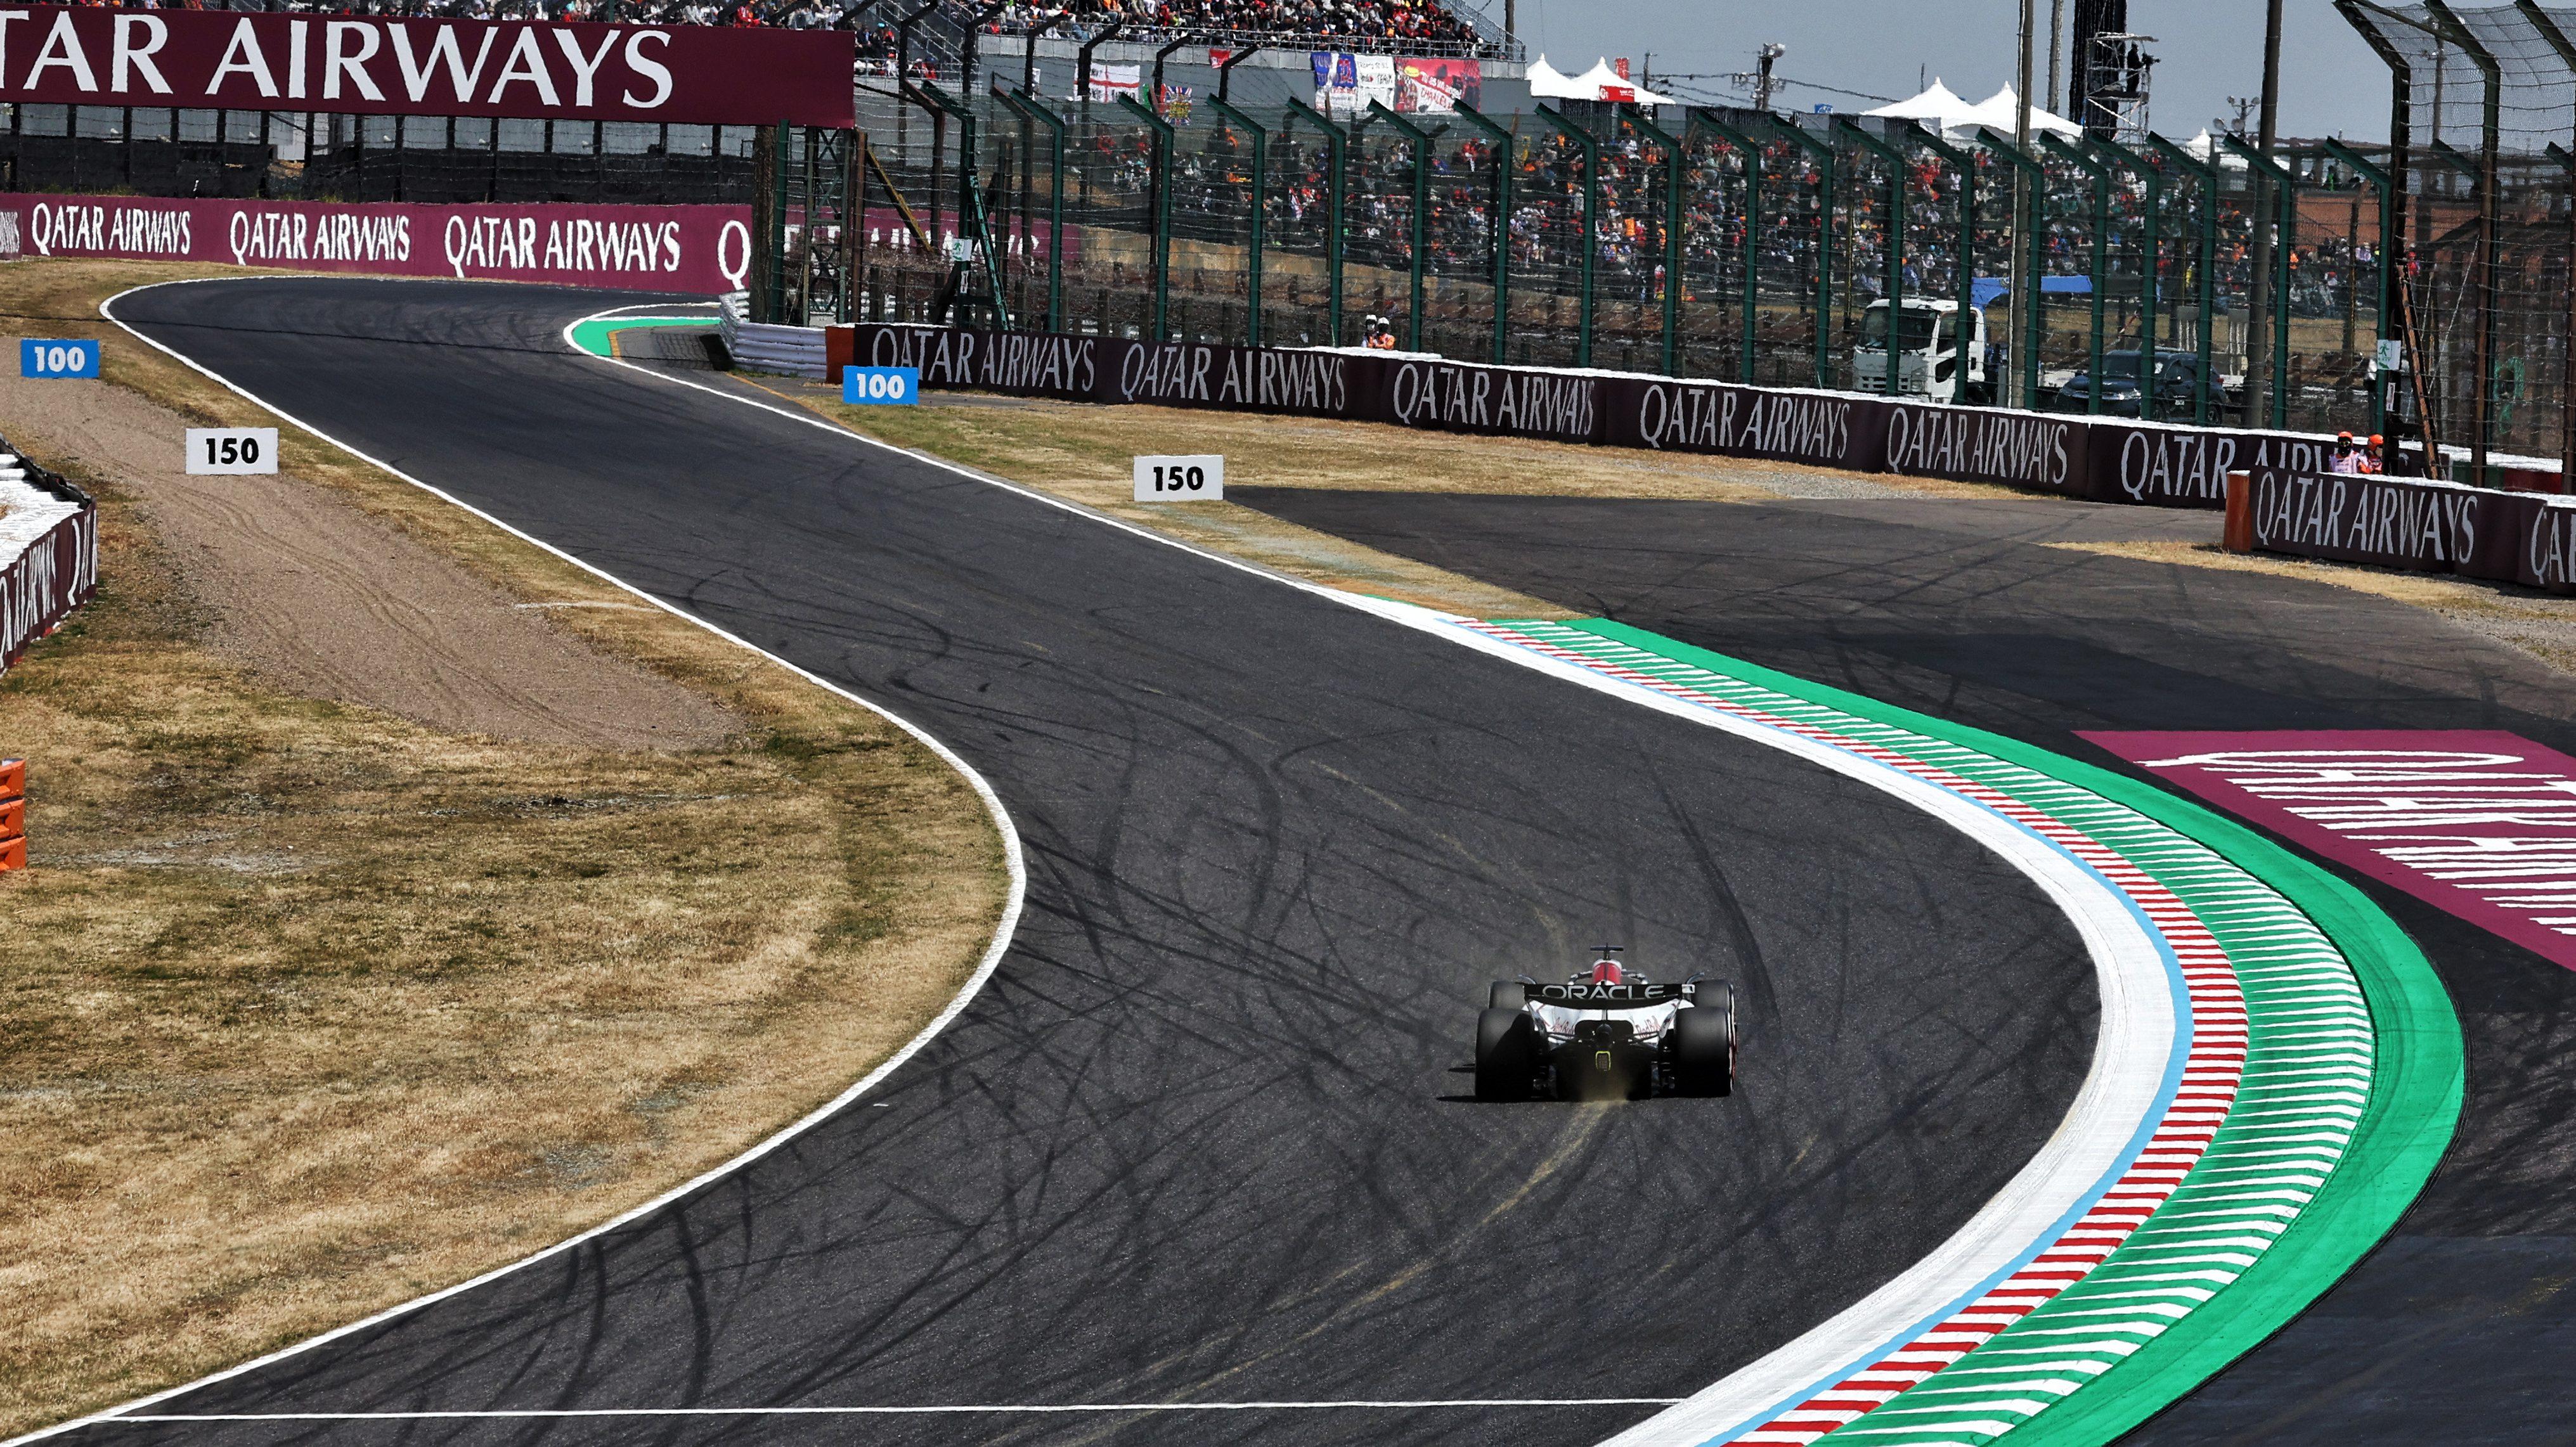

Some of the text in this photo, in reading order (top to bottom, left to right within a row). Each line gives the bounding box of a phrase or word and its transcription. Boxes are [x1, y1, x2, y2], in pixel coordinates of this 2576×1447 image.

[205, 16, 673, 108] AIRWAYS
[32, 202, 104, 256] QATAR
[108, 207, 191, 255] AIRWAYS
[230, 210, 410, 266] QATAR AIRWAYS
[444, 215, 536, 278] QATAR
[543, 219, 680, 273] AIRWAYS
[34, 346, 85, 372] 100
[857, 373, 905, 399] 100
[872, 328, 1095, 392] QATAR AIRWAYS
[1121, 343, 1345, 412] QATAR AIRWAYS
[1393, 363, 1595, 435] QATAR AIRWAYS
[1640, 384, 1851, 461] QATAR AIRWAYS
[206, 437, 259, 465] 150
[1887, 407, 2068, 484] QATAR AIRWAYS
[2121, 431, 2236, 500] QATAR
[1153, 466, 1204, 492] 150
[2256, 471, 2478, 563] QATAR AIRWAYS
[1542, 984, 1664, 1000] ORACLE
